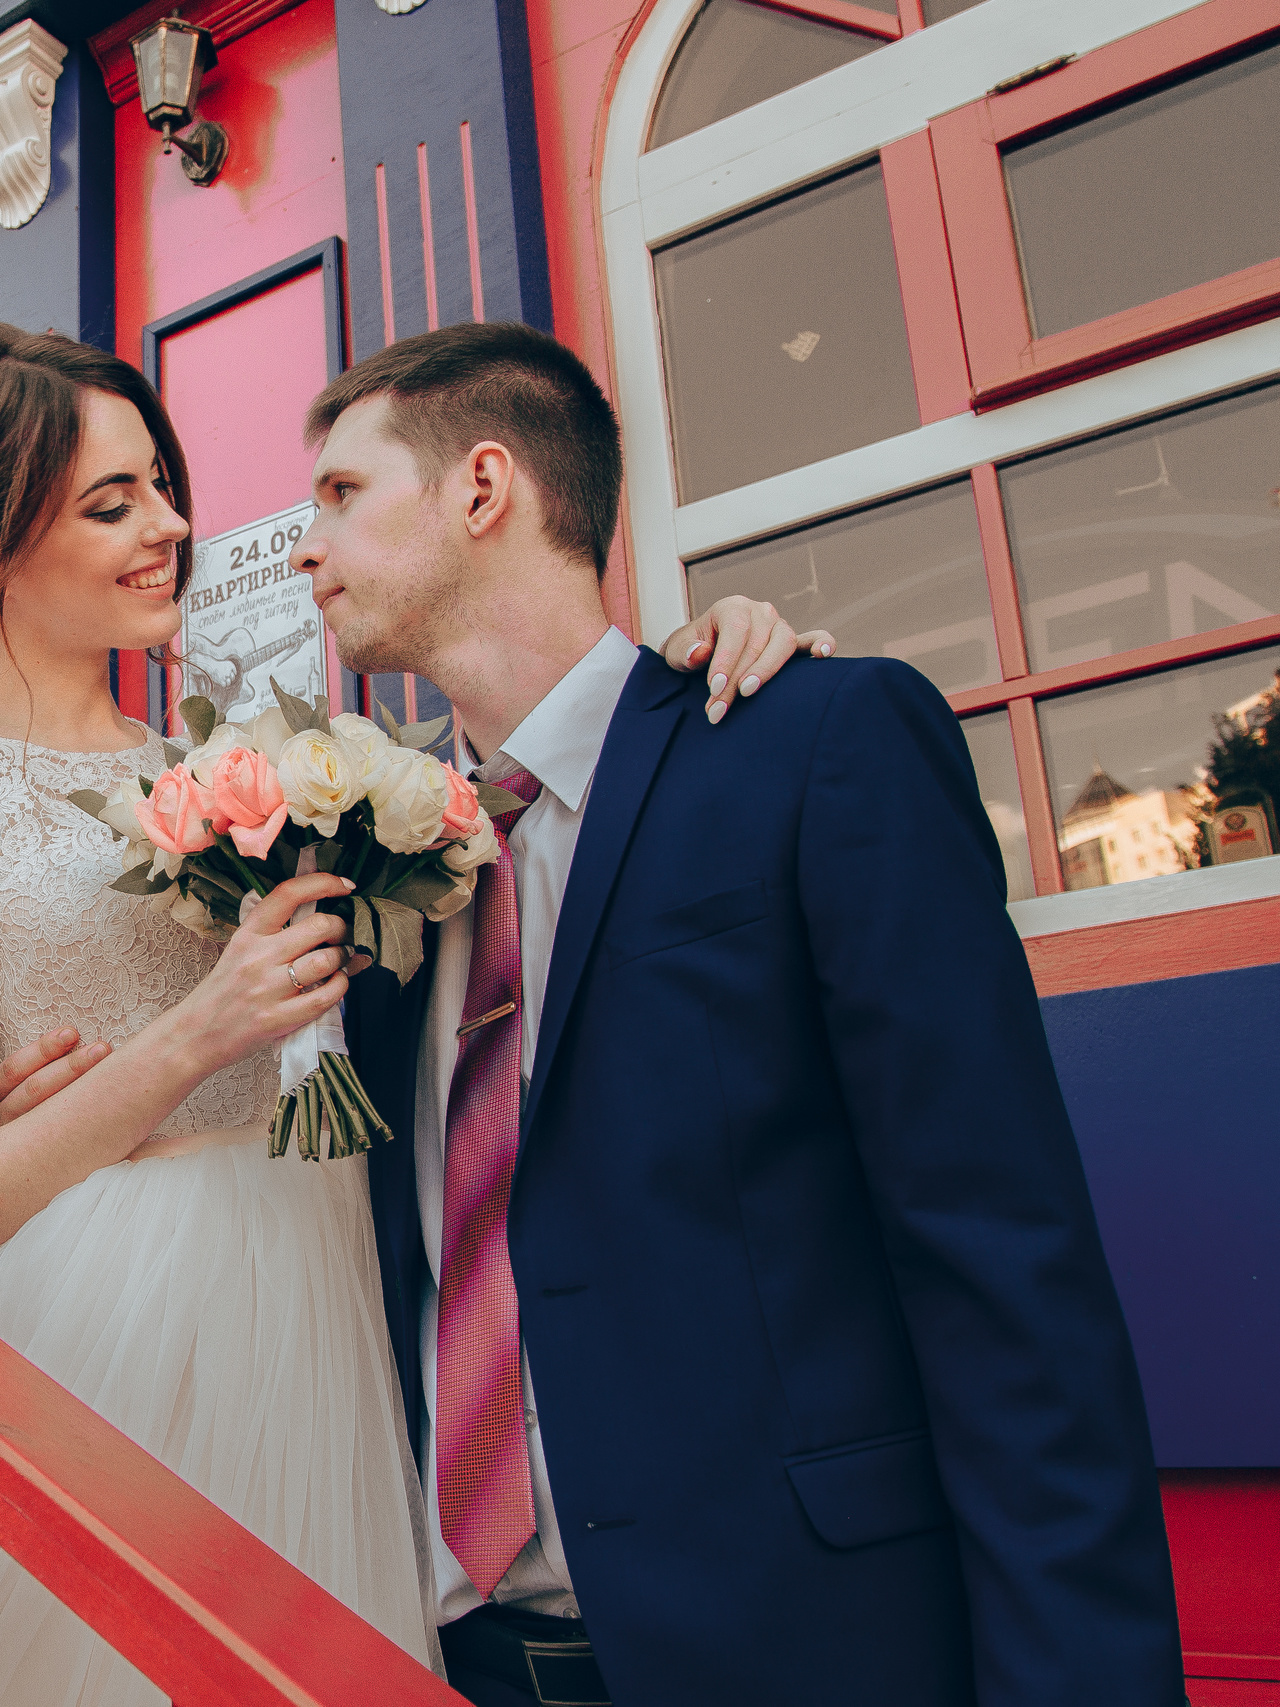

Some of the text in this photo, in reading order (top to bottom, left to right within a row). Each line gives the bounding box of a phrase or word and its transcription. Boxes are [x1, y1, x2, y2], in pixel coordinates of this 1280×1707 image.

[230, 525, 303, 571] 24.09
[229, 592, 276, 618] любимые
[281, 581, 311, 597] песни
[243, 600, 299, 630] под гитару
